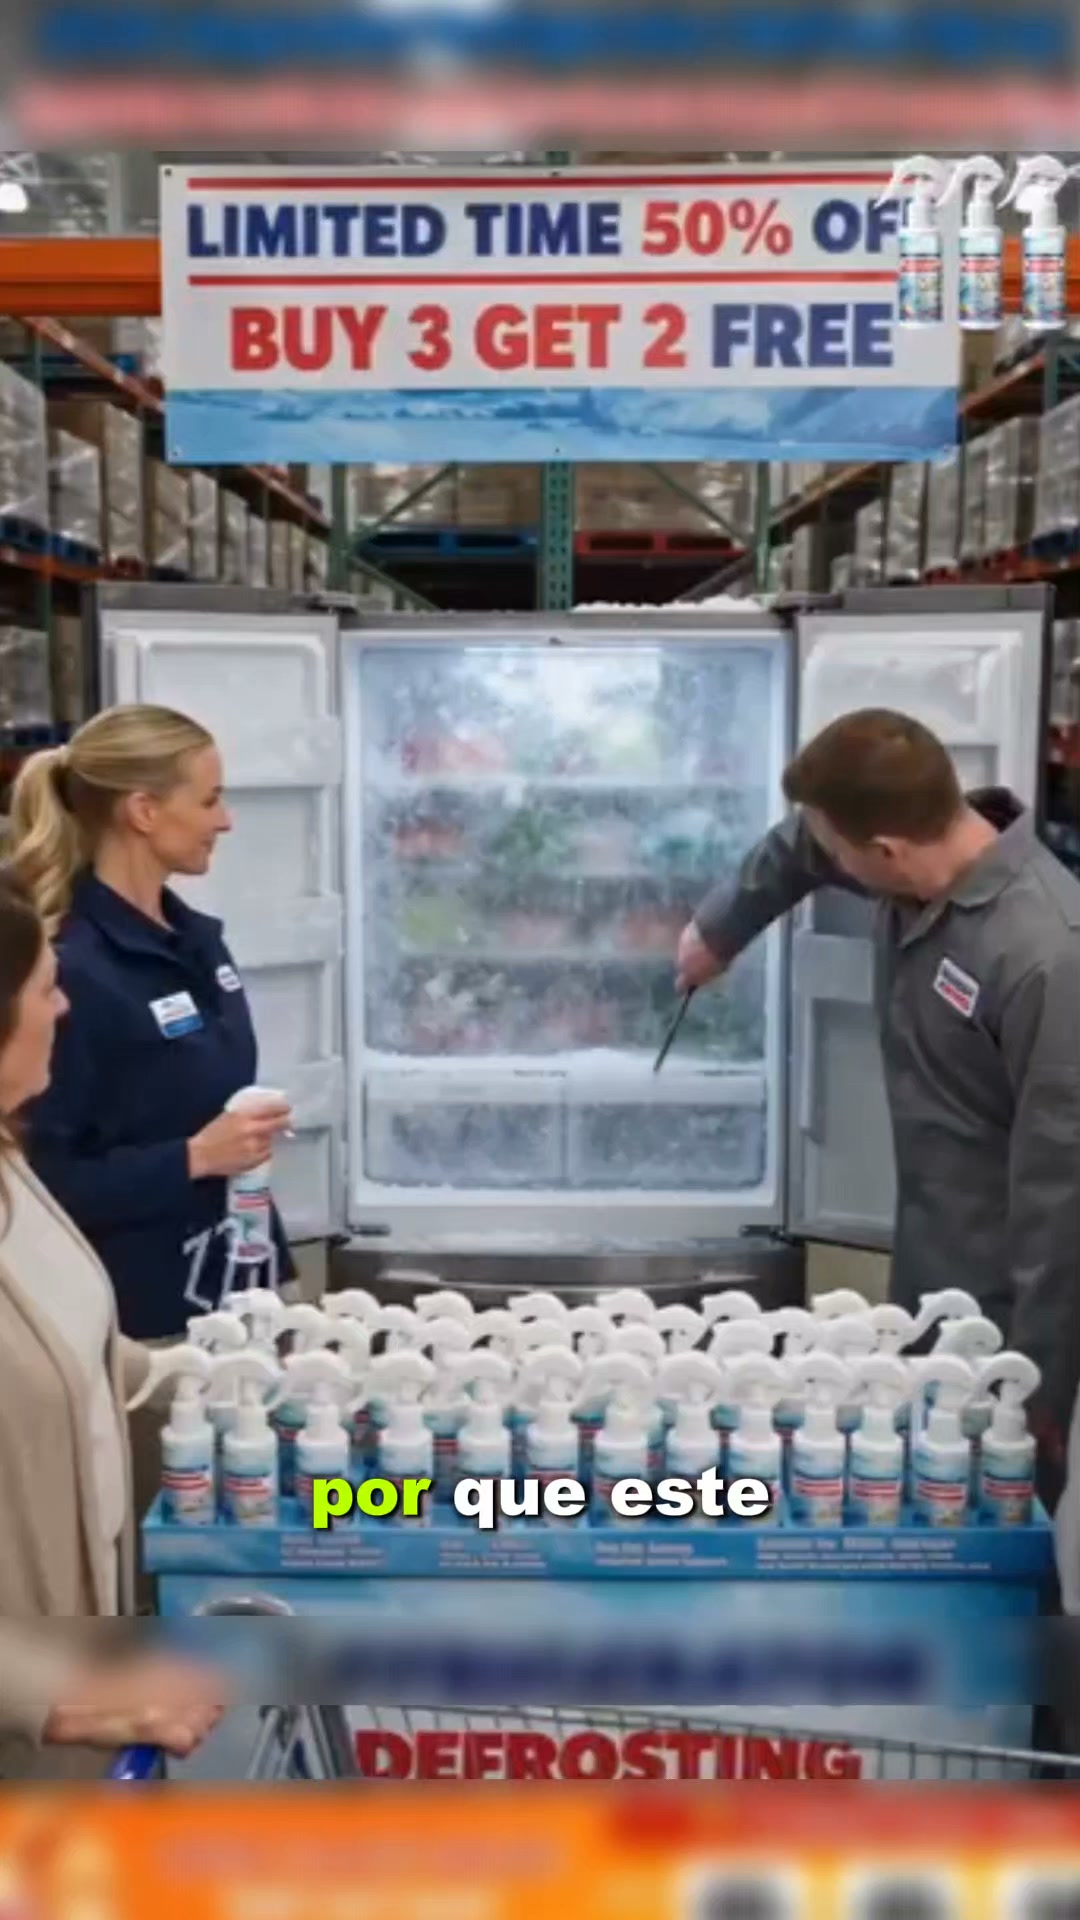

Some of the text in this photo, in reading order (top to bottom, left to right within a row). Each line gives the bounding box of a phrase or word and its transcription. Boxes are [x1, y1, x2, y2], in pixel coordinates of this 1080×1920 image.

[187, 197, 912, 258] LIMITED TIME 50% OF
[229, 301, 895, 373] BUY 3 GET 2 FREE
[354, 1728, 863, 1780] DEFROSTING
